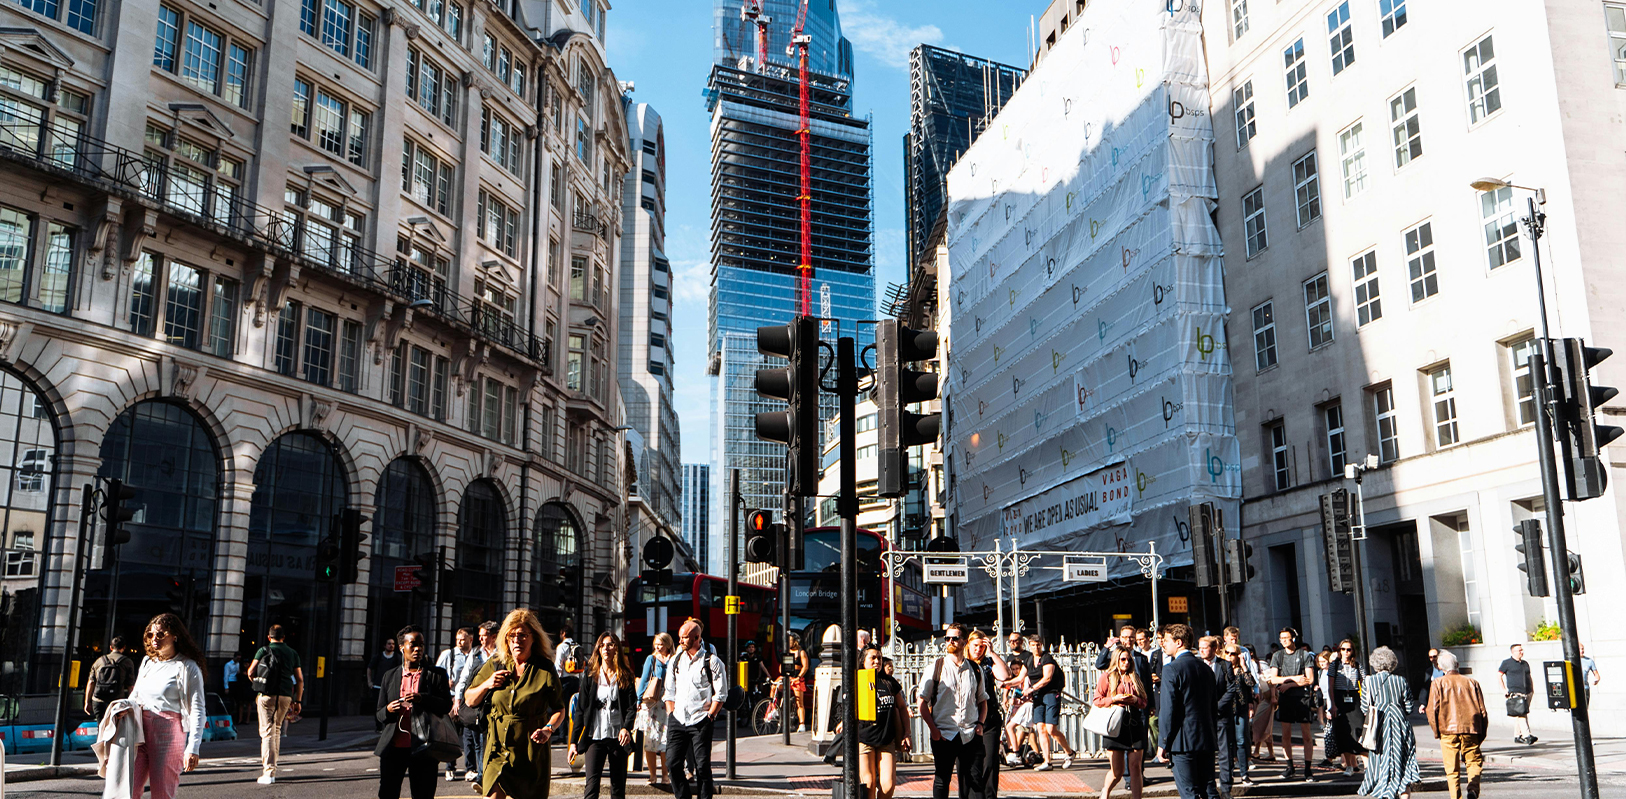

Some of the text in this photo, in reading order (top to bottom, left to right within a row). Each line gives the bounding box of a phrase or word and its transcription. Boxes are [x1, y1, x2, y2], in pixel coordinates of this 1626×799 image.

[1224, 462, 1240, 474] bsp
[1102, 468, 1128, 486] VAGA
[1102, 486, 1128, 503] BOND
[1024, 515, 1033, 534] WE
[1033, 510, 1046, 531] ARE
[1047, 504, 1062, 526] OPEN
[1064, 499, 1074, 520] AS
[1075, 491, 1098, 516] USUAL
[818, 590, 838, 599] Bridge
